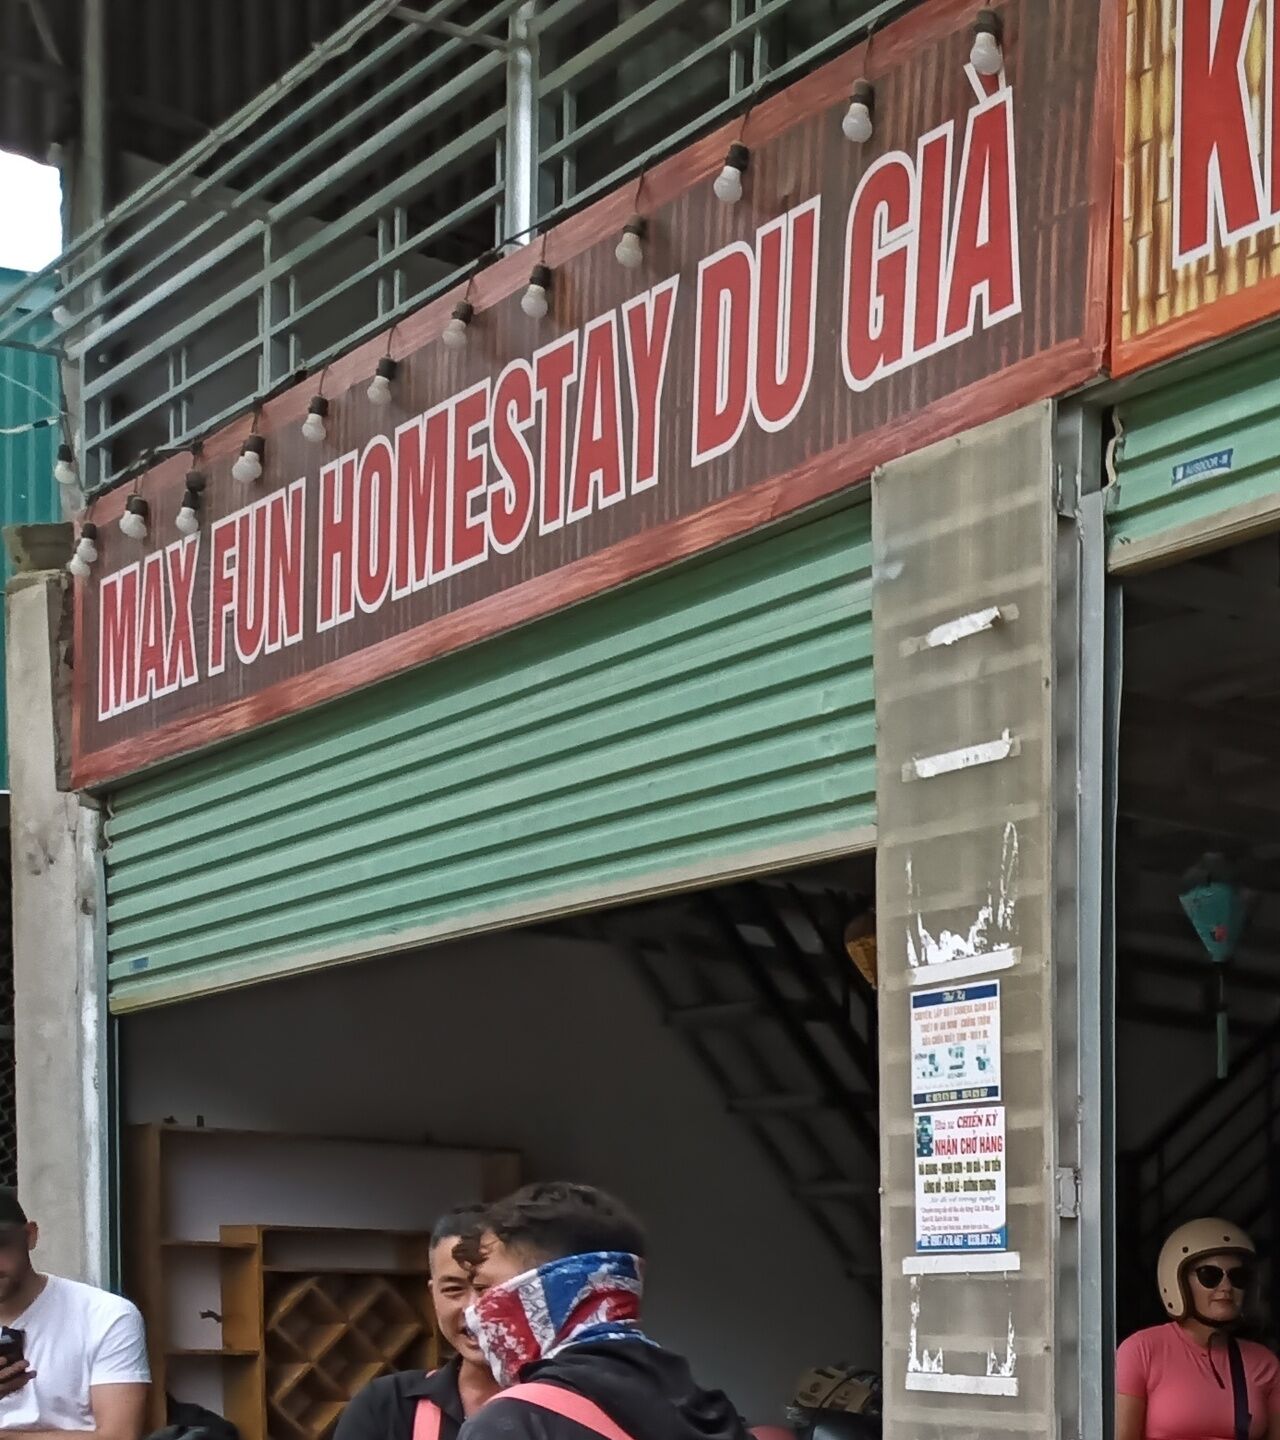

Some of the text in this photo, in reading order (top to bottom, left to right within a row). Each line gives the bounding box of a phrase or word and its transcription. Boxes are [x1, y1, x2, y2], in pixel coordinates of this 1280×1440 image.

[97, 62, 1022, 722] MAX FUN HOMESTAY DU GIÀ
[979, 1132, 1003, 1153] HÀNG
